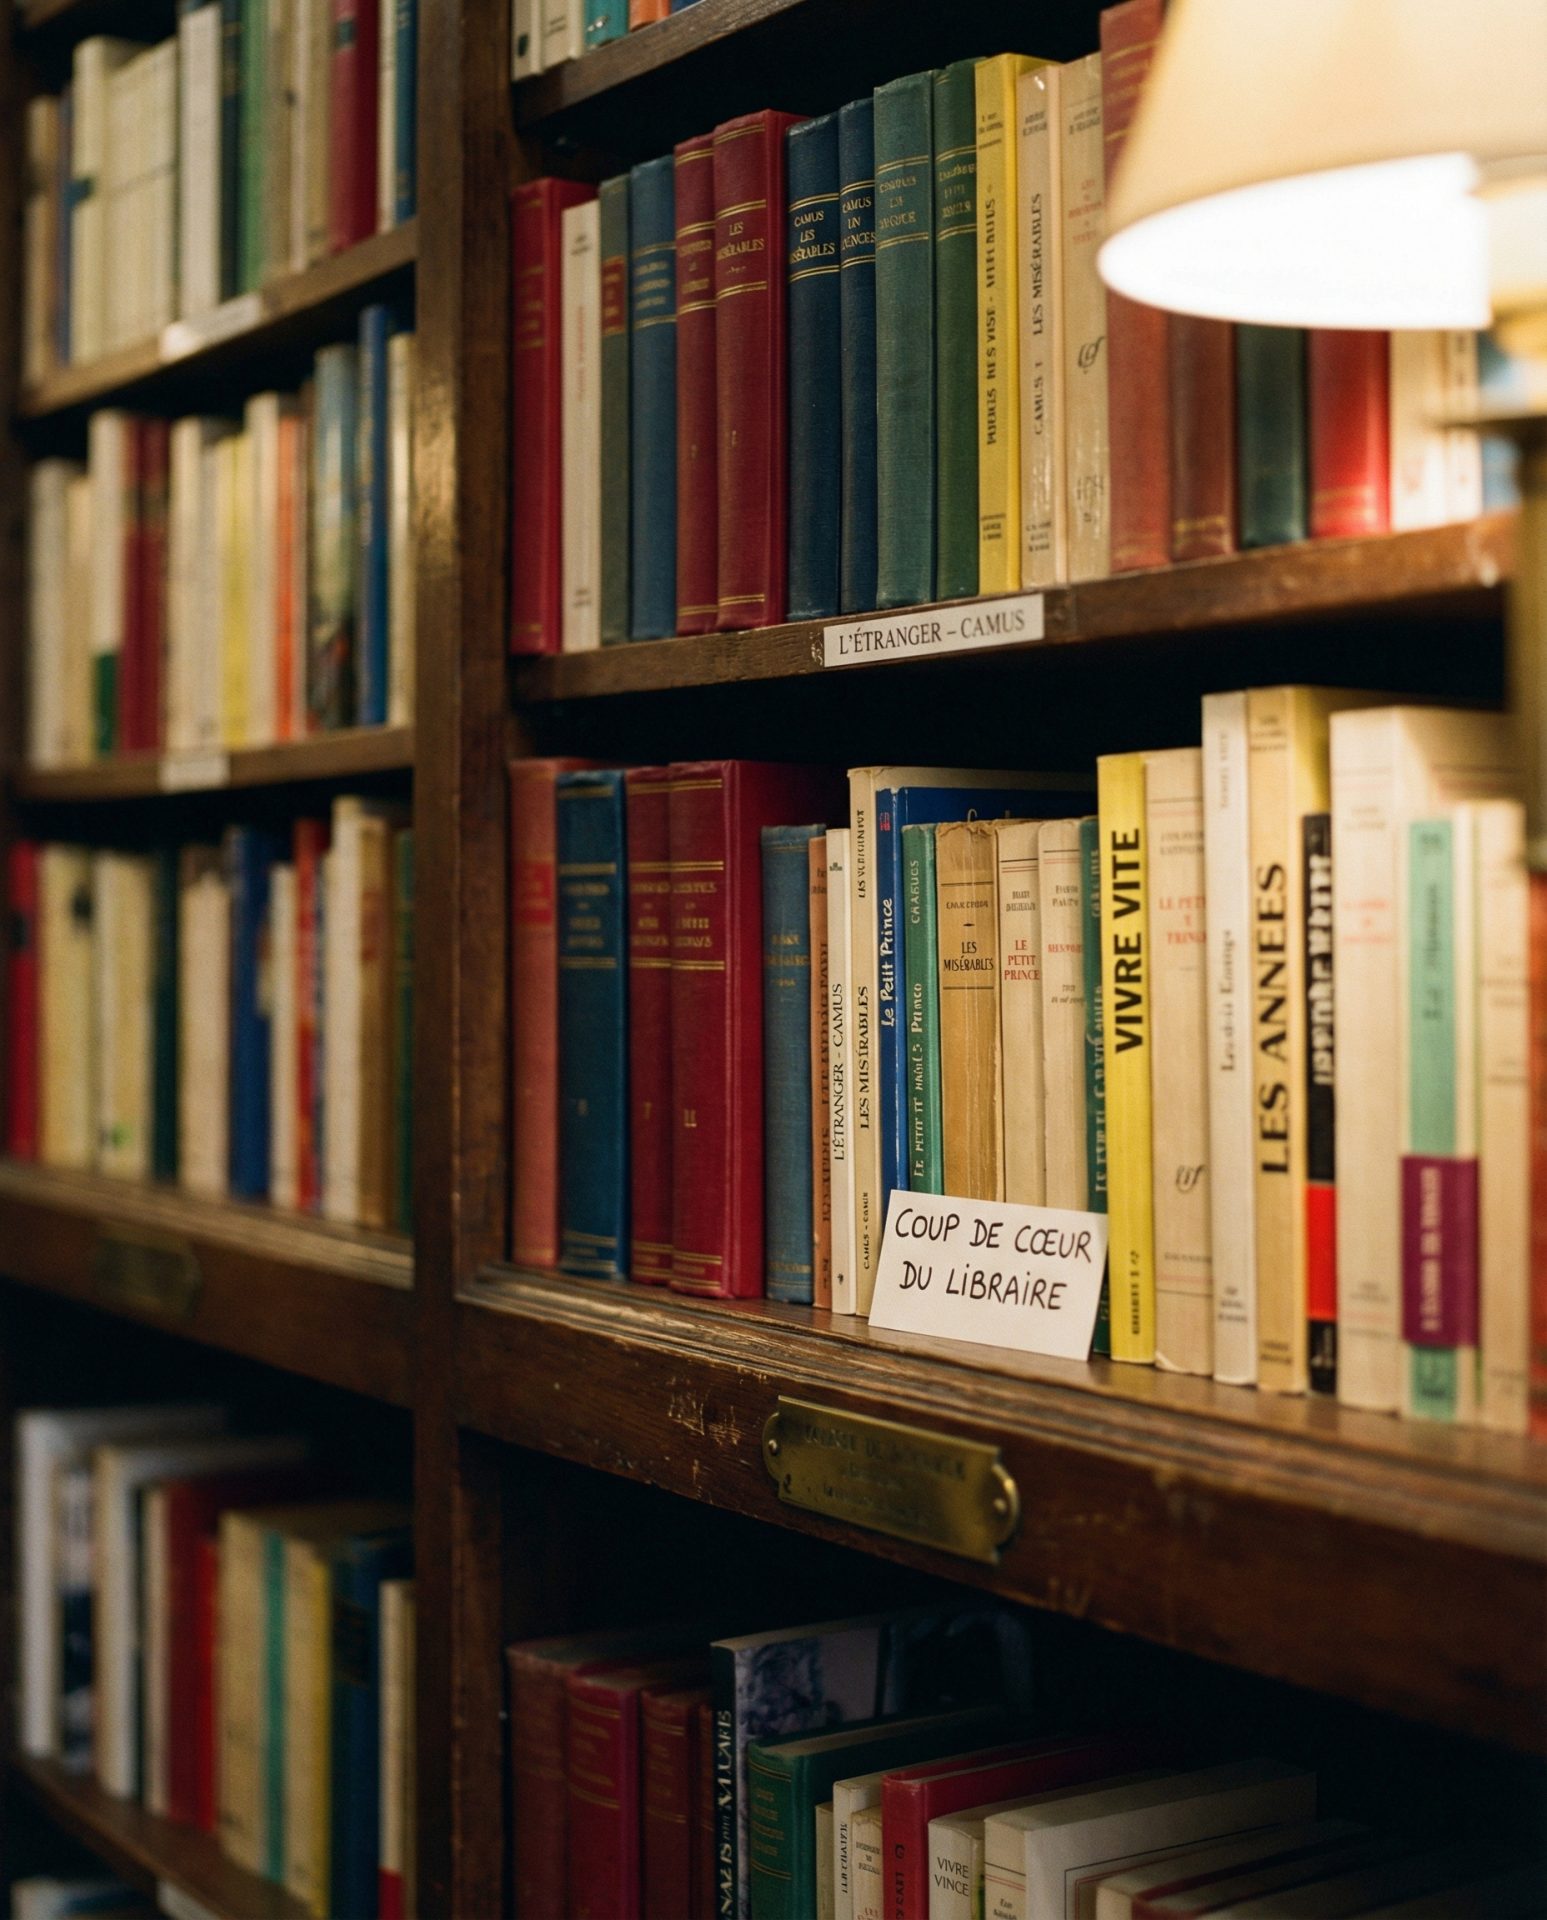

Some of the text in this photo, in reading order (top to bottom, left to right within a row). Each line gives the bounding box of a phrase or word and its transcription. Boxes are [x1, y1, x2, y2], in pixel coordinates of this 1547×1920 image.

[842, 196, 872, 213] CAMUS
[794, 210, 825, 227] CAMUS
[1032, 303, 1042, 335] LES
[839, 622, 942, 654] L'ÉTRANGER
[961, 609, 1025, 638] CAMUS
[880, 897, 894, 956] Prince
[961, 941, 977, 954] LES
[1015, 939, 1027, 951] LE
[1111, 829, 1143, 1054] VIVRE VITE
[1007, 955, 1036, 966] PETIT
[1004, 969, 1041, 981] PRINCE
[832, 983, 844, 1047] CAMUS
[881, 1007, 895, 1026] Le
[1256, 863, 1289, 1174] LES ANNEES
[860, 1097, 870, 1129] LES
[895, 1208, 1092, 1263] COUP DE CŒUR
[899, 1260, 933, 1290] DU
[936, 1856, 969, 1879] VIVRE
[934, 1873, 969, 1896] VINCE
